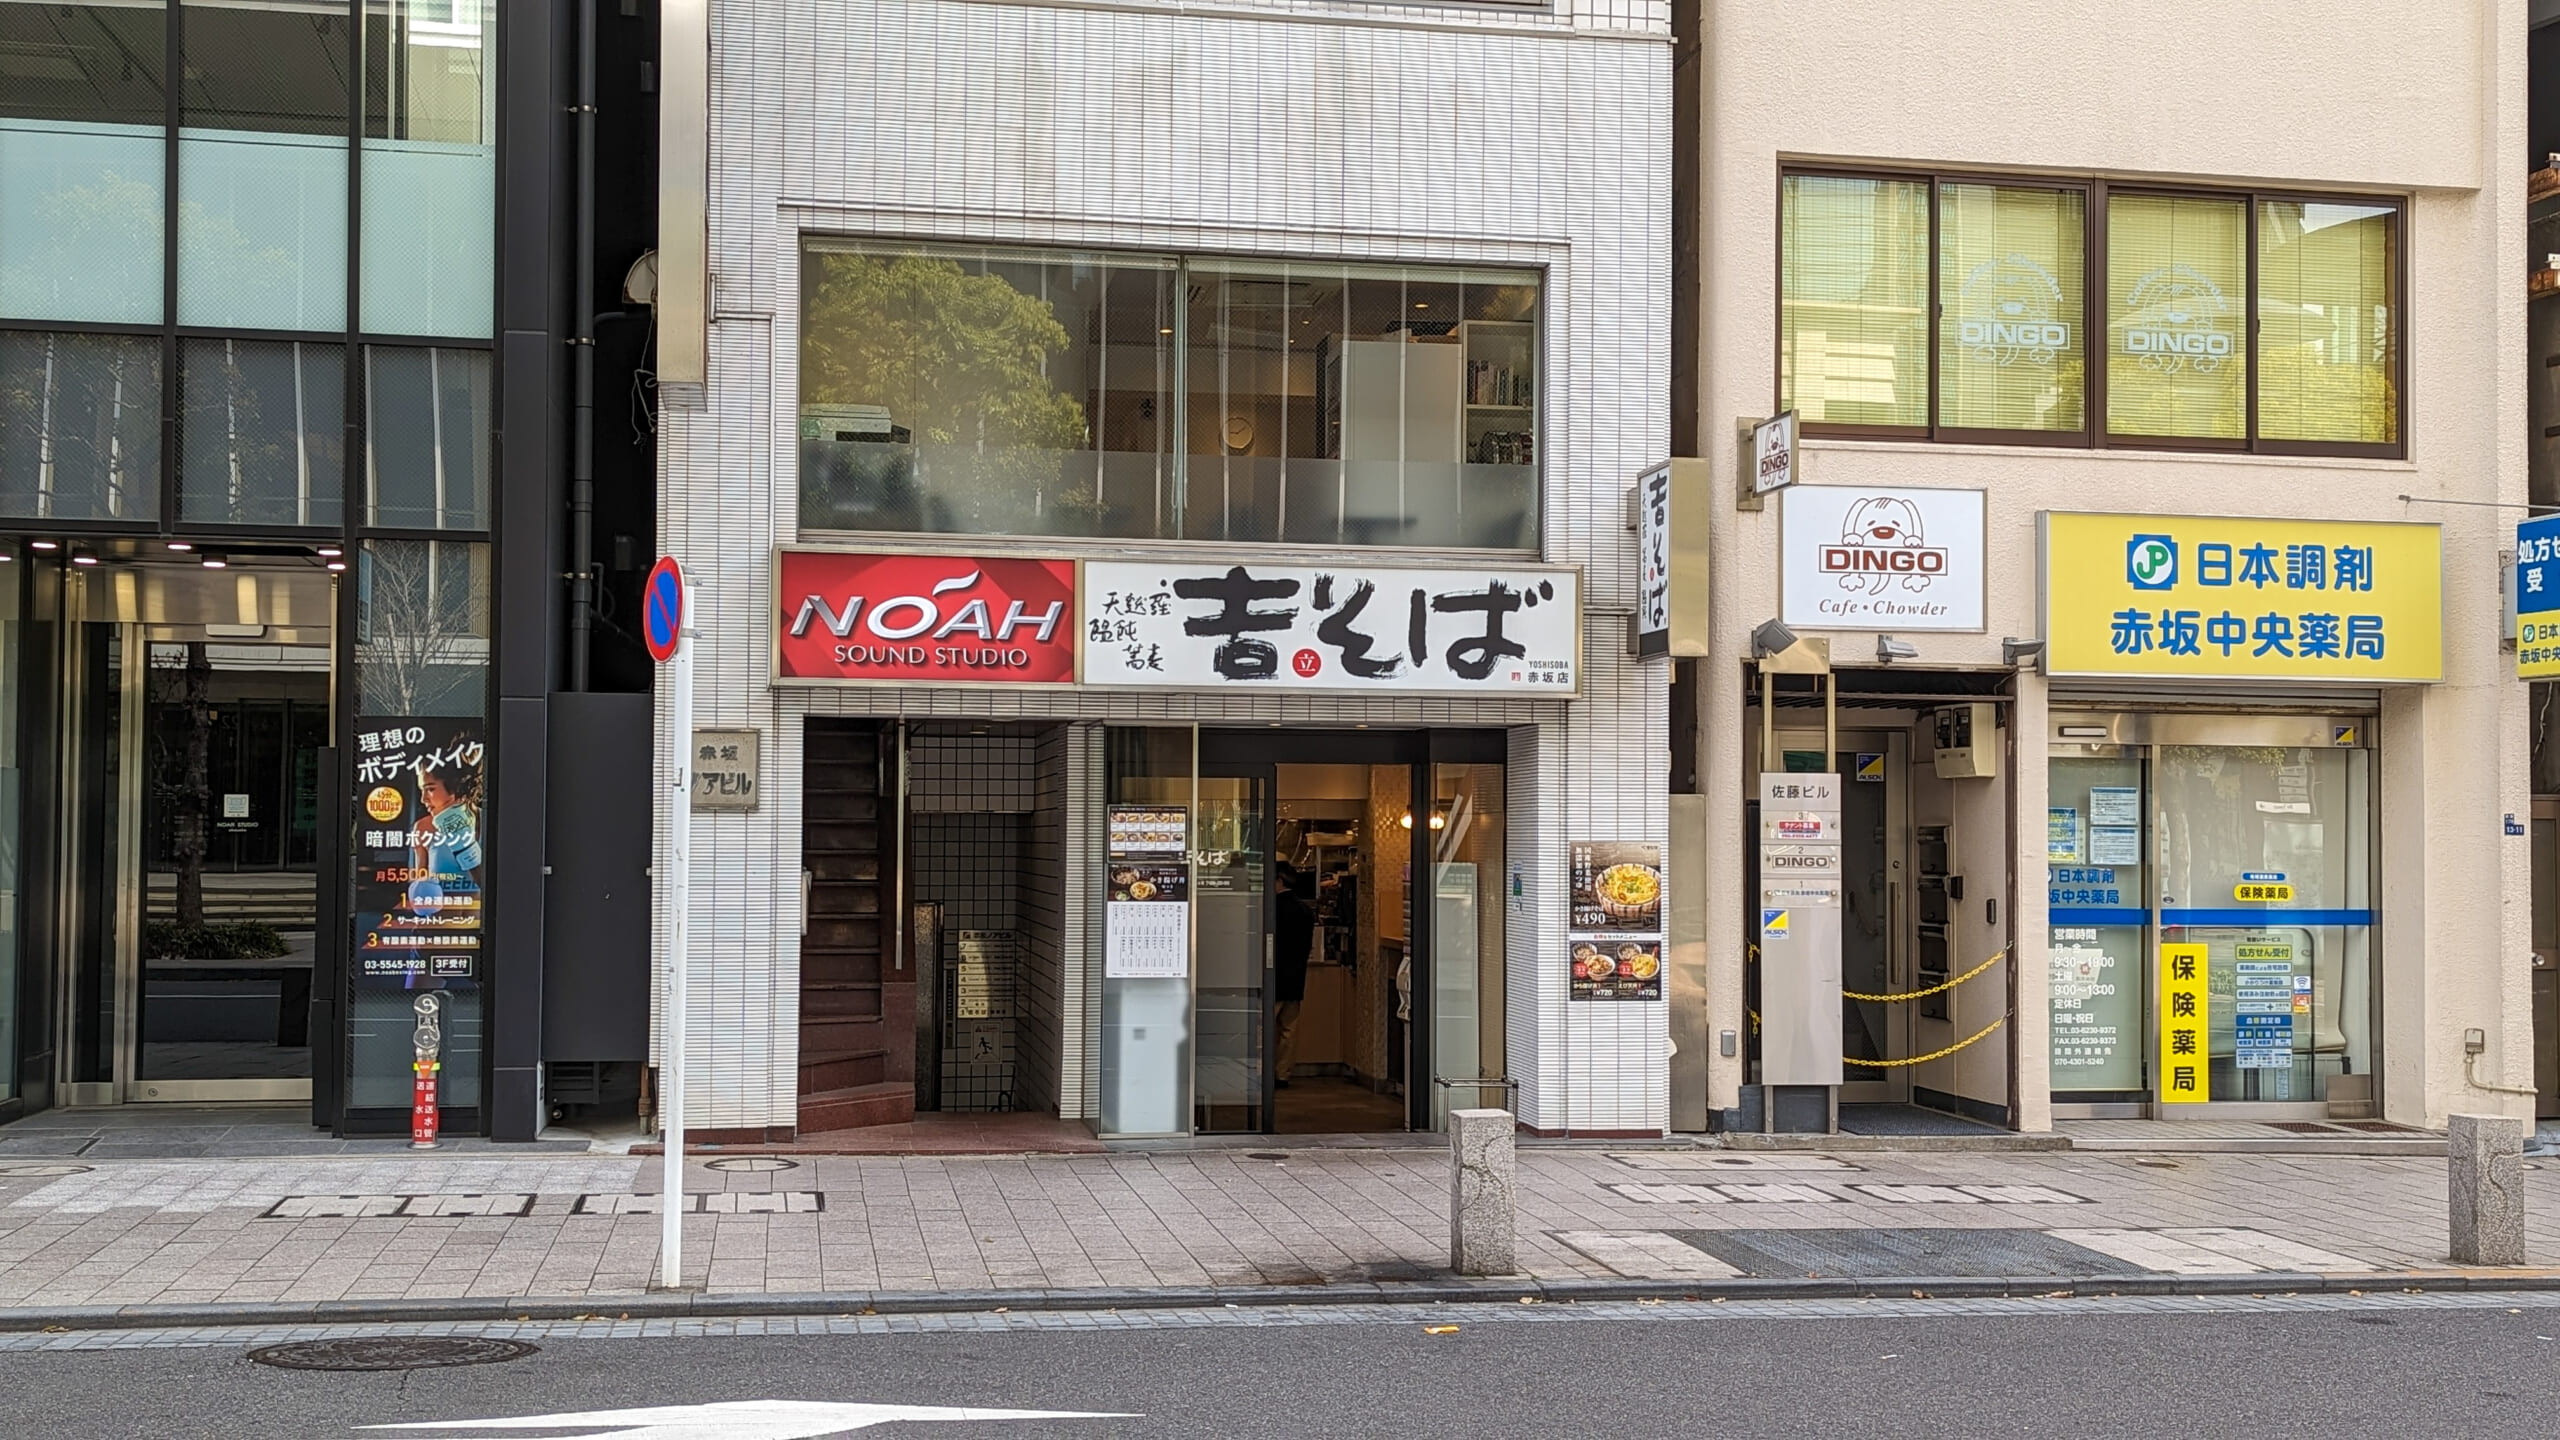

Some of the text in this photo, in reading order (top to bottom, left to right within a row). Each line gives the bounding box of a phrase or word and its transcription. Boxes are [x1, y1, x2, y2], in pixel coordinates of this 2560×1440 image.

[1961, 322, 2066, 346] DINGO
[2127, 330, 2229, 354] DINGO
[1760, 452, 1789, 475] DINGO
[1649, 473, 1668, 629] 吉そば
[1826, 548, 1943, 572] DINGO
[2197, 542, 2373, 592] 日本調剤
[2527, 567, 2543, 593] 受
[1819, 598, 1949, 617] Cafe Chowder
[790, 594, 1065, 641] NOAH
[1173, 566, 1554, 680] 吉そば
[2111, 608, 2385, 660] 赤坂中央薬局
[834, 645, 1028, 667] SOUND STUDIO
[1297, 653, 1316, 672] 立
[1528, 660, 1569, 669] YOSHISOBA
[1528, 671, 1569, 684] 赤坂店
[358, 725, 426, 754] 理想の
[699, 745, 738, 761] 赤坂
[357, 741, 484, 784] ボディメイク
[1771, 784, 1830, 799] 佐藤ビル
[1798, 812, 1804, 820] 3
[365, 830, 475, 848] 暗闇ボクシング
[1798, 847, 1804, 855] 2
[1775, 857, 1828, 867] DINGO
[2058, 868, 2115, 884] 日本調剤
[400, 893, 407, 908] 1
[2240, 886, 2289, 899] 保険薬局
[383, 913, 393, 928] 2
[397, 915, 475, 926] サーキットトレーニング
[1575, 912, 1606, 925] ¥490
[367, 932, 378, 948] 3
[2054, 928, 2097, 940] 営業時間
[2238, 948, 2289, 958] 処方せん受付
[364, 960, 426, 969] 03-5545-1928
[435, 959, 468, 969] 3F受付
[2054, 998, 2082, 1009] 定休日
[2171, 954, 2197, 1093] 保険薬局
